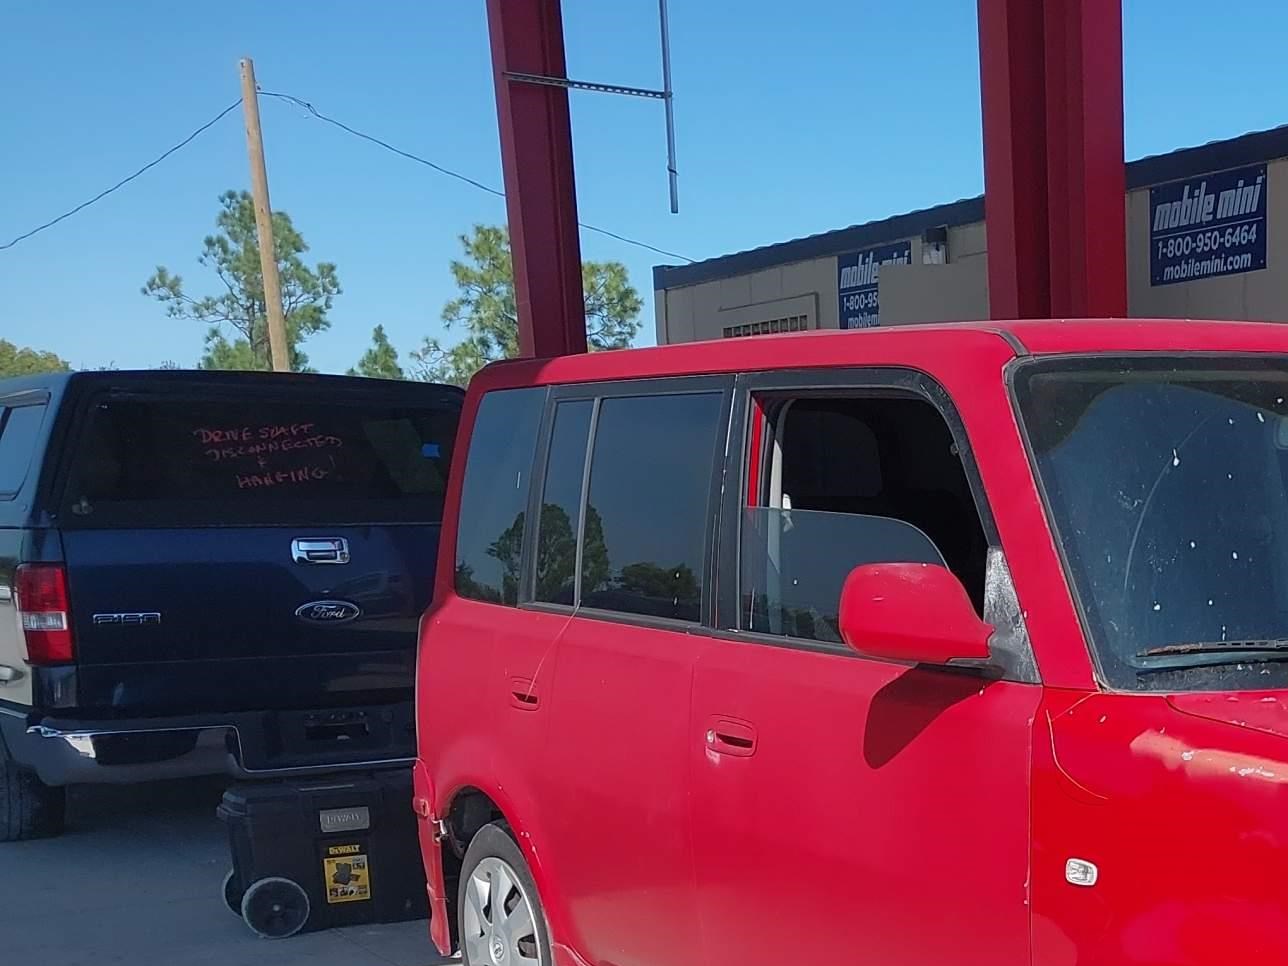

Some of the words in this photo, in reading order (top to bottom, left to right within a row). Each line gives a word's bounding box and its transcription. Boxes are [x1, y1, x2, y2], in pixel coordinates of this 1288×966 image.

[1153, 181, 1215, 232] mobile
[1216, 176, 1262, 220] mini
[1157, 223, 1256, 259] 1-800-950-6464
[840, 251, 879, 289] mobile
[1163, 252, 1252, 281] mobilemini.com
[843, 292, 879, 312] 1-800-95
[192, 427, 253, 444] DRIVE
[204, 435, 343, 462] DISCONNECTED
[310, 604, 345, 619] Ford
